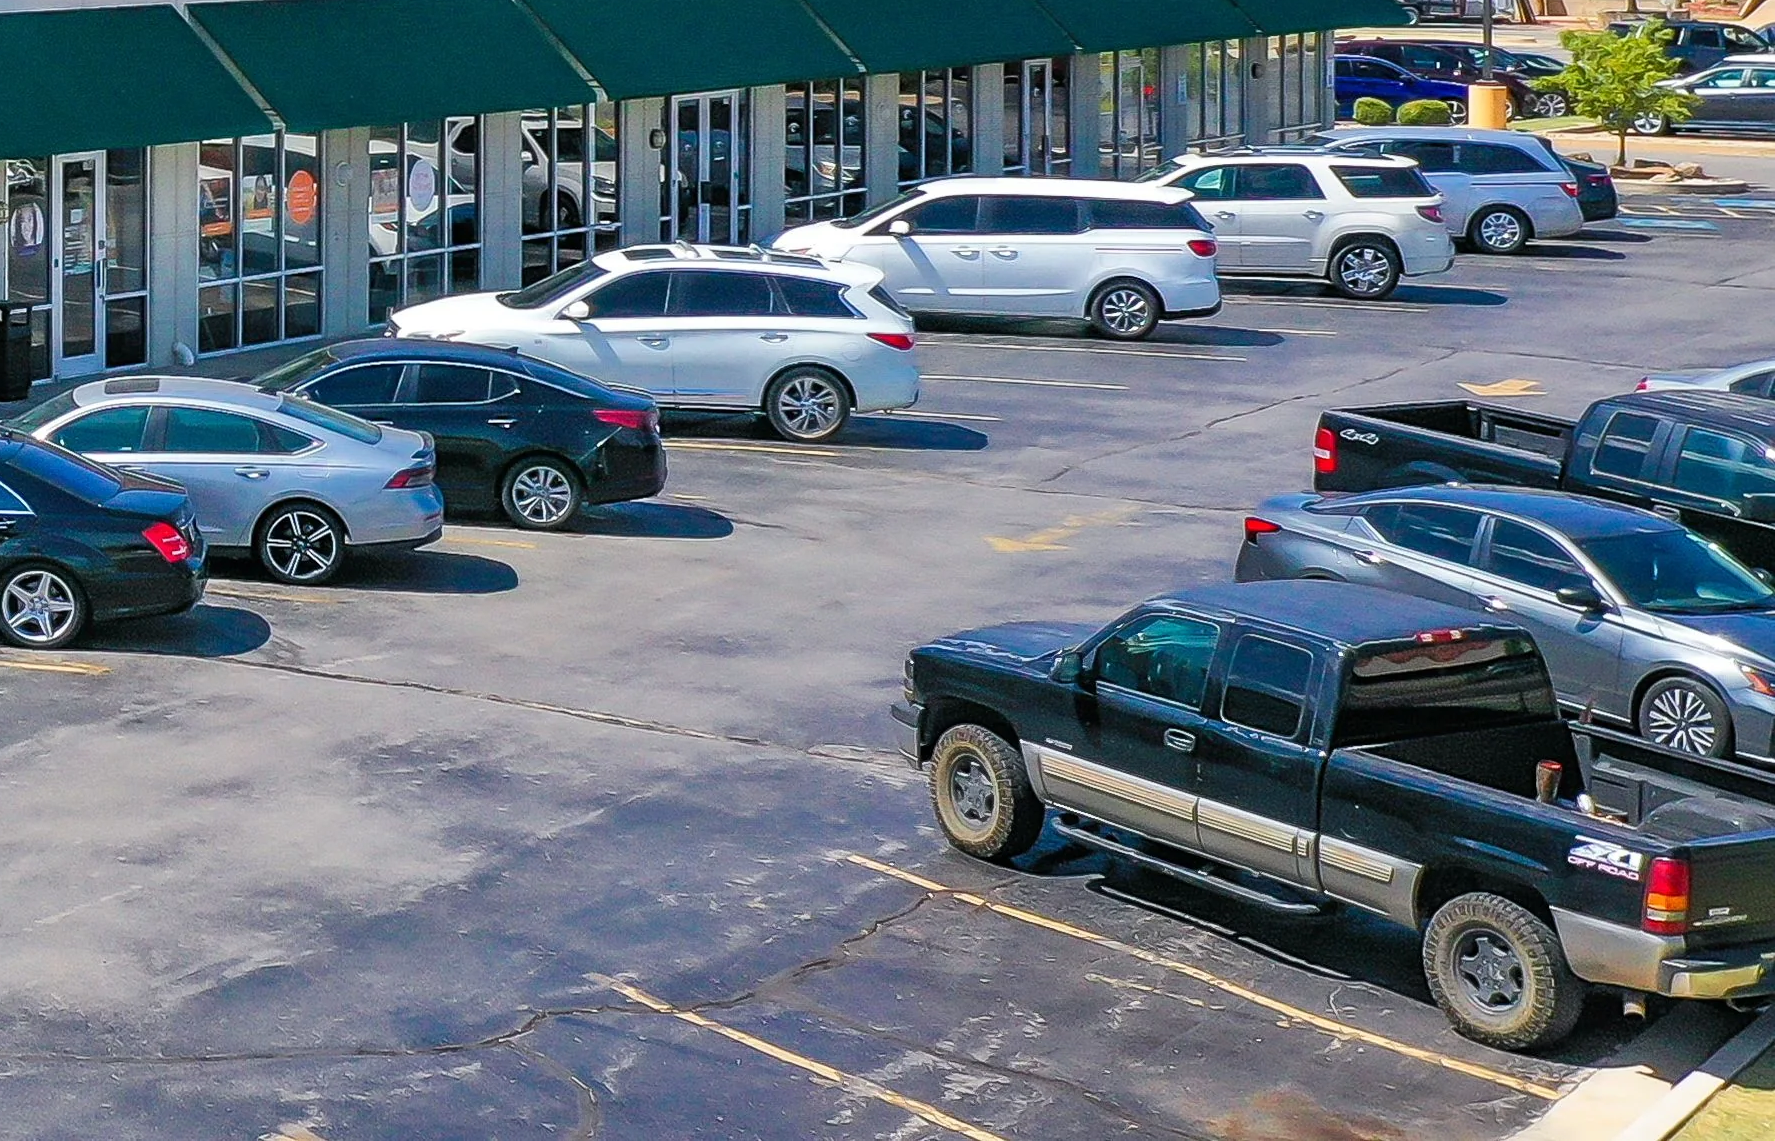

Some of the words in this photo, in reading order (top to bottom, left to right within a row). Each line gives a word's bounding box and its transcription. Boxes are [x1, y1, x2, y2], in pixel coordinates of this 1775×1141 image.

[1567, 855, 1596, 868] OFF
[1597, 863, 1640, 881] ROAD
[1569, 835, 1642, 872] Z71
